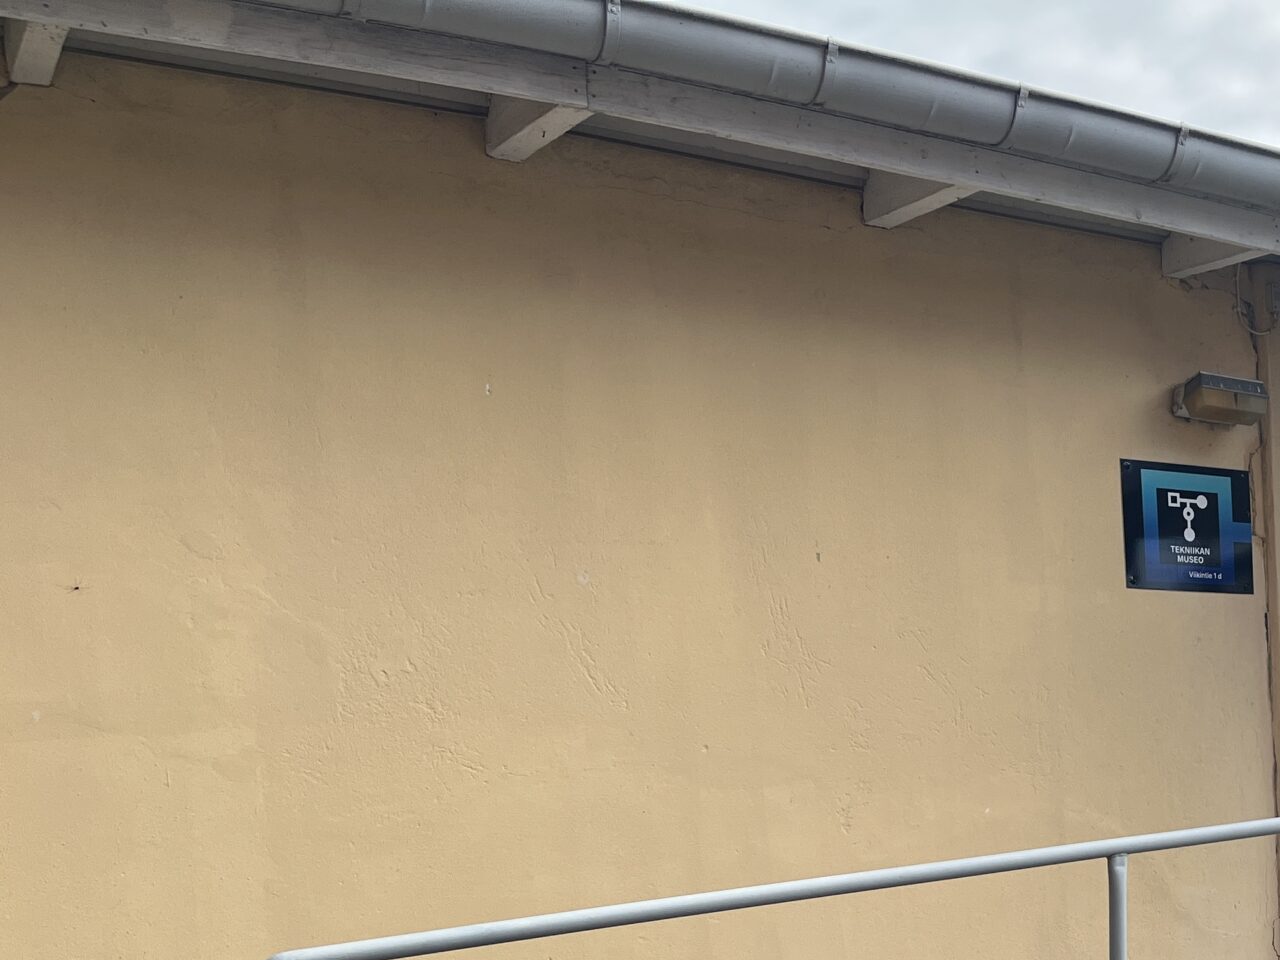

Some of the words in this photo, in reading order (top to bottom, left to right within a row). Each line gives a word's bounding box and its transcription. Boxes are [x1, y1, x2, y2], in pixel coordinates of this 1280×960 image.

[1170, 545, 1210, 555] TEKNIIKAN
[1177, 555, 1204, 564] MUSEO
[1188, 571, 1212, 579] Viikintie
